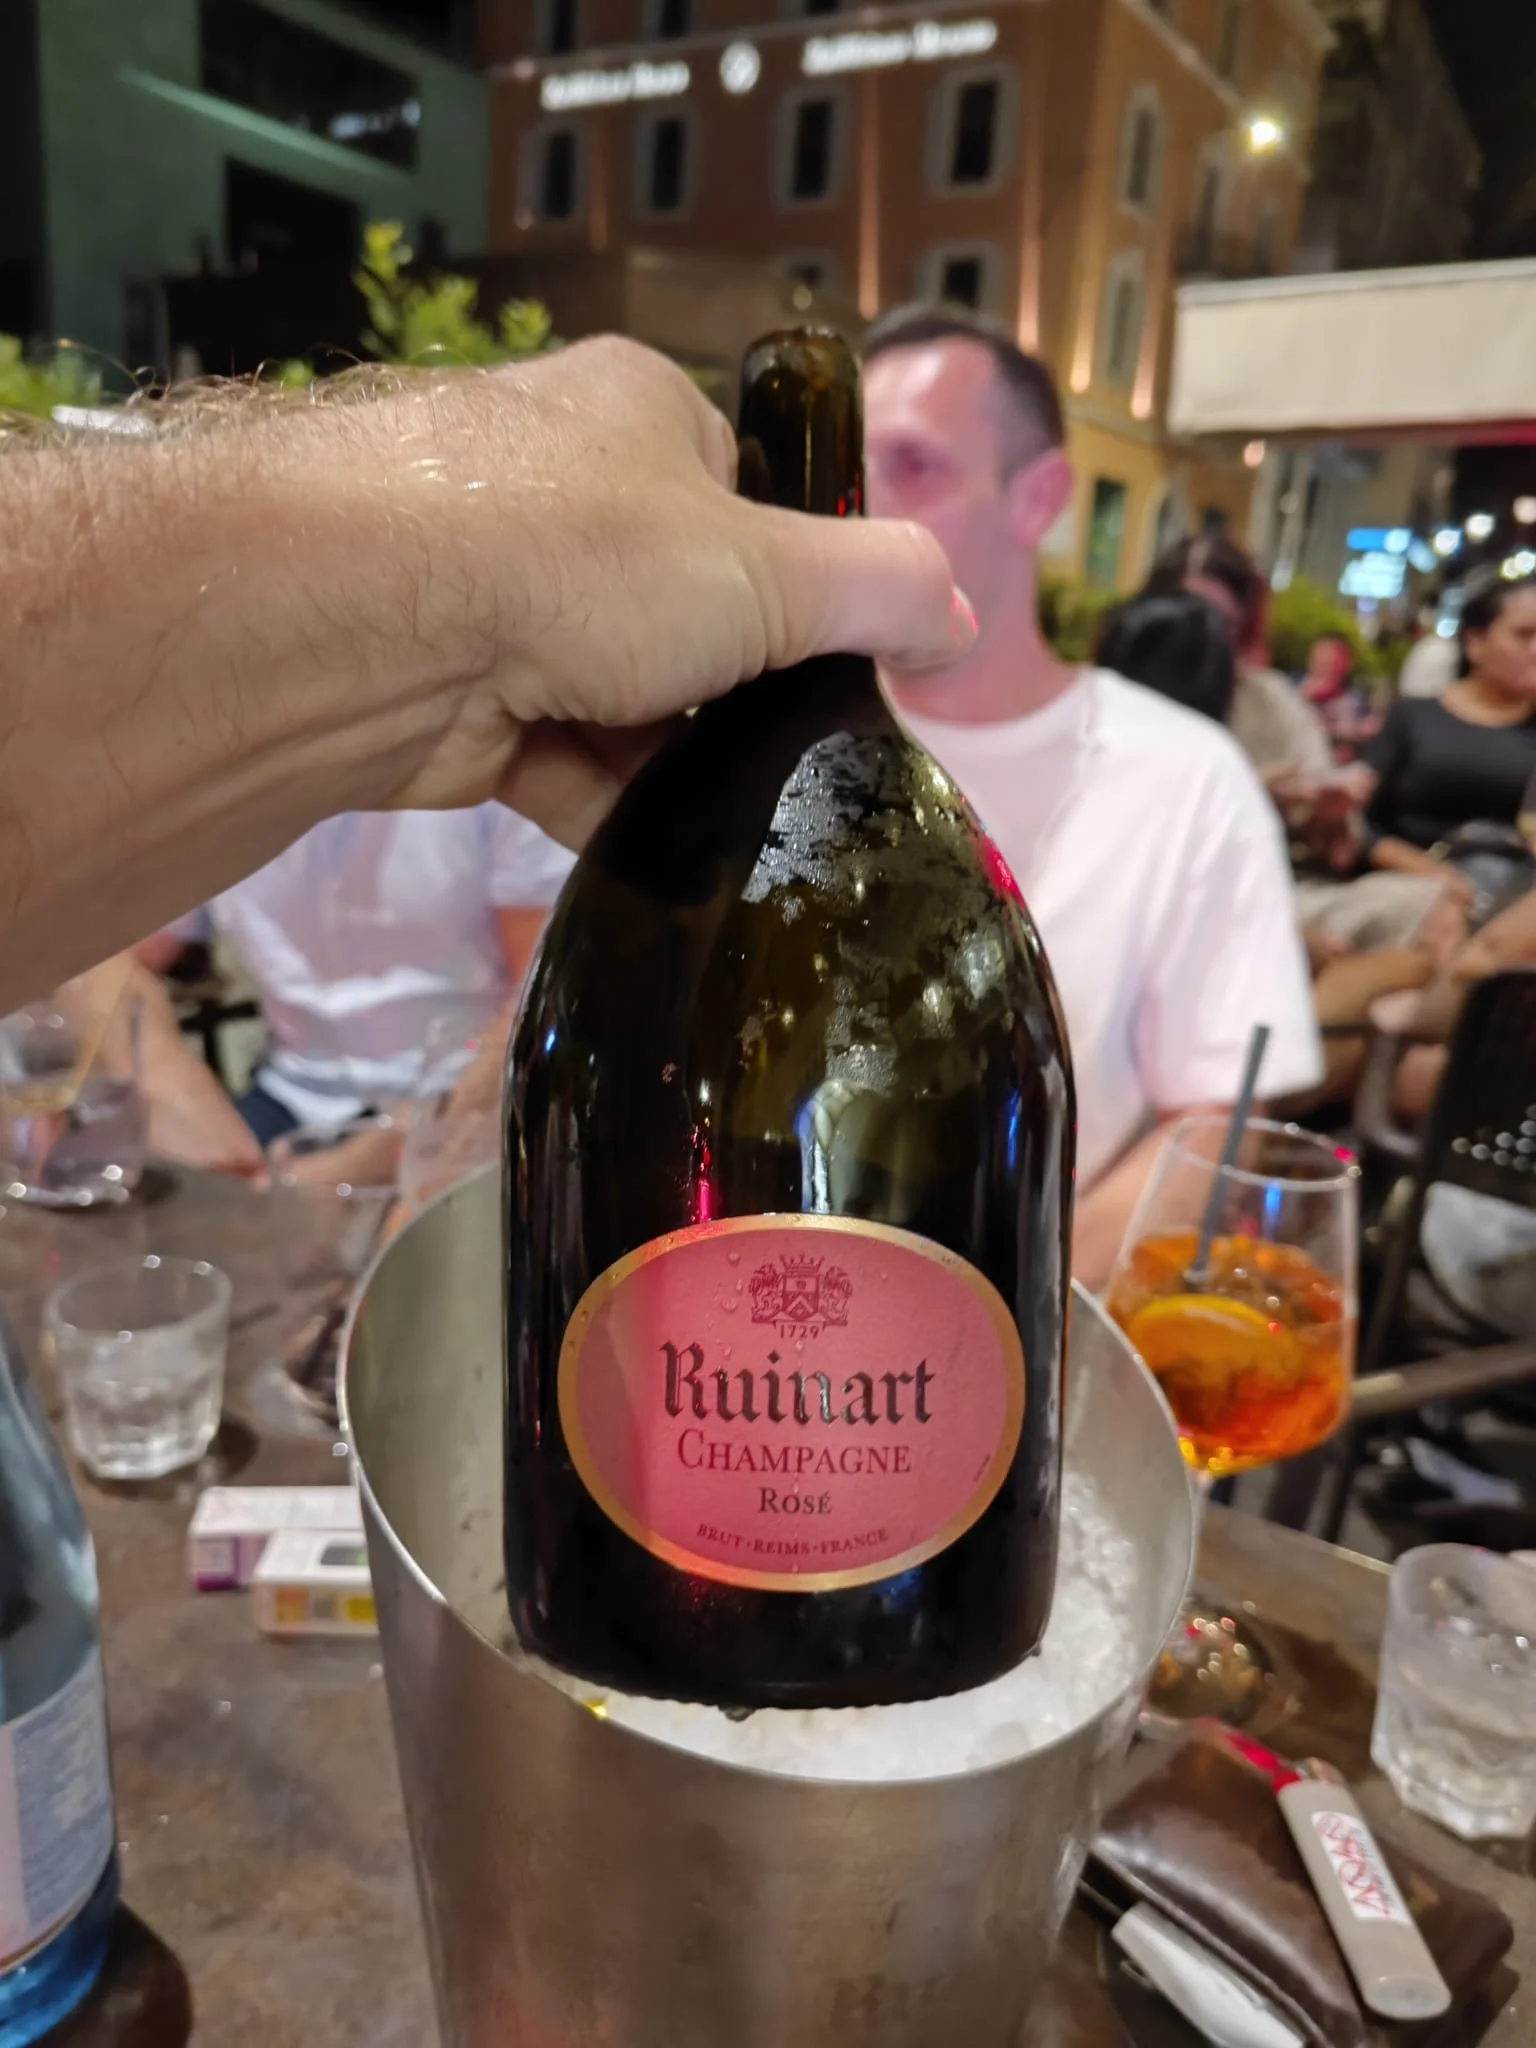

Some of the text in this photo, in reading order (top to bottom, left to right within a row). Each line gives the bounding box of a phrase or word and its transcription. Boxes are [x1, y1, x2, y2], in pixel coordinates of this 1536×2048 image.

[780, 1324, 820, 1339] 1729
[660, 1341, 936, 1425] Ruinart
[677, 1429, 911, 1474] CHAMPAGNE
[758, 1487, 832, 1515] ROSÉ
